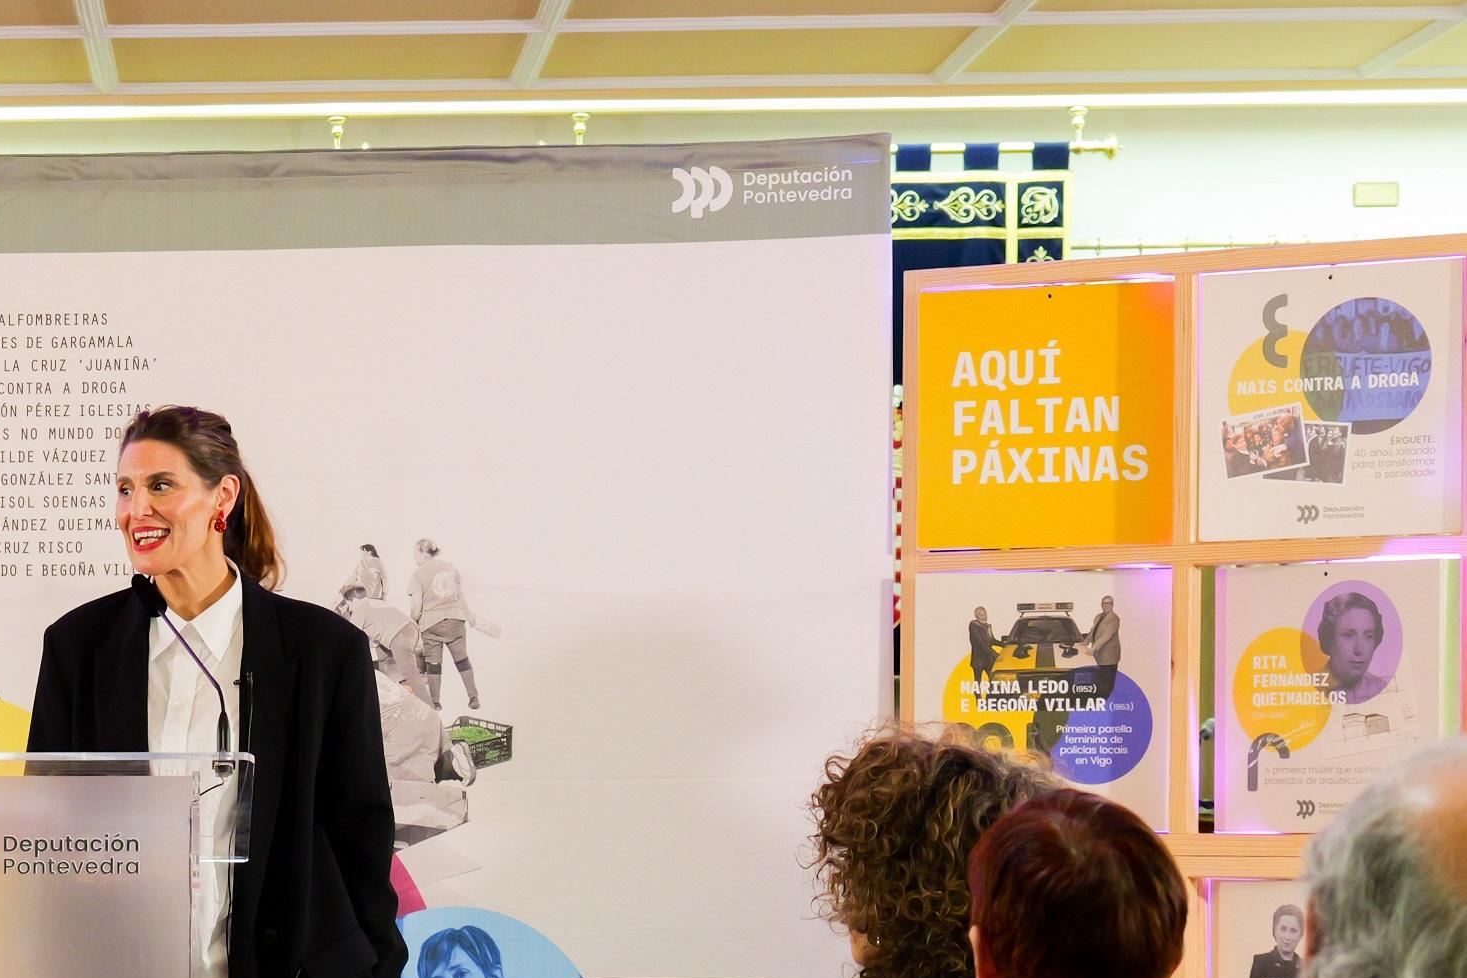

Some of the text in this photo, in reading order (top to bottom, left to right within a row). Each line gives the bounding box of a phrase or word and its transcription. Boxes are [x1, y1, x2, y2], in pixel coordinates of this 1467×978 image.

[744, 165, 852, 189] Deputación
[744, 186, 852, 204] Pontevedra
[26, 336, 43, 349] DE
[51, 336, 133, 349] GARGAMALA
[4, 360, 20, 372] LA
[32, 359, 67, 372] CRUZ
[952, 340, 1062, 392] AQUÍ
[63, 382, 71, 395] A
[82, 381, 127, 394] DROGA
[1237, 372, 1420, 395] NAIS CONTRA A DROGA
[26, 402, 70, 417] PÉREZ
[953, 396, 1120, 437] FALTAN
[21, 428, 38, 441] NO
[48, 428, 94, 440] MUNDO
[105, 428, 121, 440] DO
[1390, 435, 1436, 445] ÉRGUETE:
[42, 448, 106, 463] VÁZQUEZ
[1354, 449, 1366, 458] 40
[1396, 446, 1436, 456] loitando
[952, 440, 1149, 485] PÁXINAS
[1352, 457, 1436, 472] para transformar
[1, 470, 74, 486] GONZÁLEZ
[1384, 468, 1436, 478] sociedade
[43, 496, 106, 508] SOENGAS
[38, 542, 83, 554] RISCO
[26, 564, 33, 577] E
[42, 560, 95, 577] BEGOÑA
[1252, 656, 1286, 670] RITA
[1253, 670, 1330, 688] FERNÁNDEZ
[960, 680, 1021, 694] MARINA
[1028, 680, 1069, 694] LEDO
[960, 698, 970, 712] E
[977, 695, 1038, 712] BEGOÑA
[1044, 698, 1106, 712] VILLAR
[1252, 690, 1346, 707] QUEIMADELOS
[1056, 724, 1132, 736] Primeira parella
[1065, 735, 1123, 744] feminina de
[1060, 746, 1128, 756] policías locais
[1090, 757, 1112, 767] Vigo
[1336, 768, 1352, 776] que
[1264, 776, 1304, 786] proxectos
[1306, 776, 1316, 784] de
[3, 832, 140, 858] Deputación
[3, 858, 140, 876] Pontevedra
